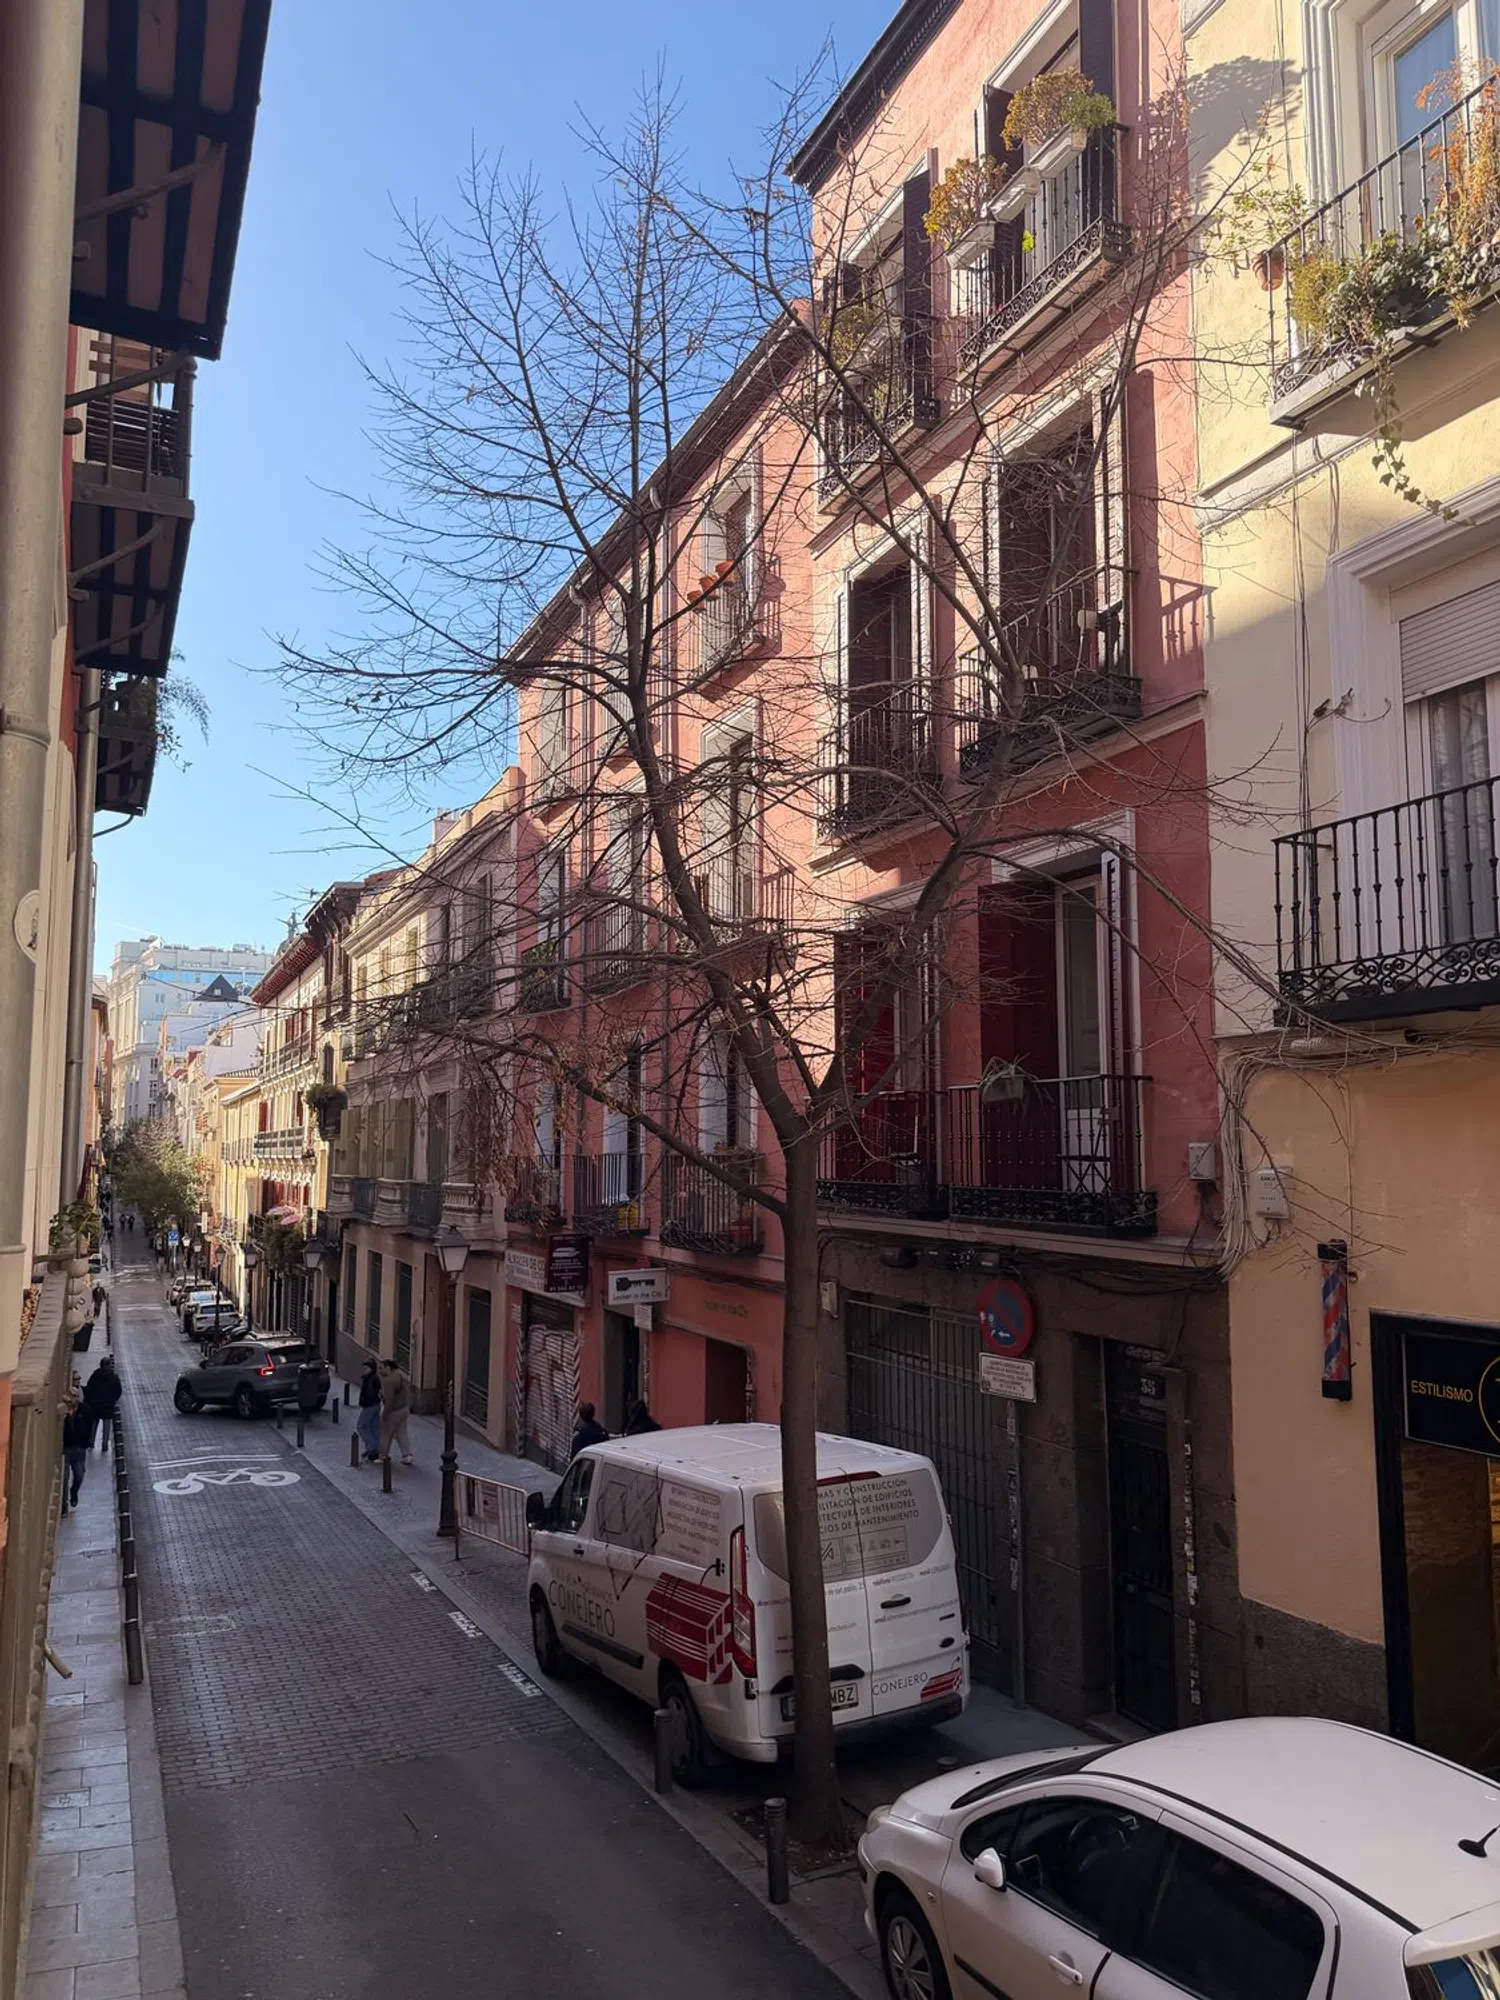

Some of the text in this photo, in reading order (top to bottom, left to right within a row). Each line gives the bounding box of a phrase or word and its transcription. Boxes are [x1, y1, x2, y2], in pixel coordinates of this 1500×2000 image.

[1410, 1380, 1473, 1403] ESTILISMO
[862, 1493, 873, 1503] DE
[875, 1488, 913, 1501] EDIFICIOS
[860, 1505, 871, 1515] DE
[872, 1499, 917, 1513] INTERIORES
[841, 1522, 852, 1531] DE
[549, 1580, 615, 1637] CONEJERO
[872, 1671, 928, 1696] CONEJERO
